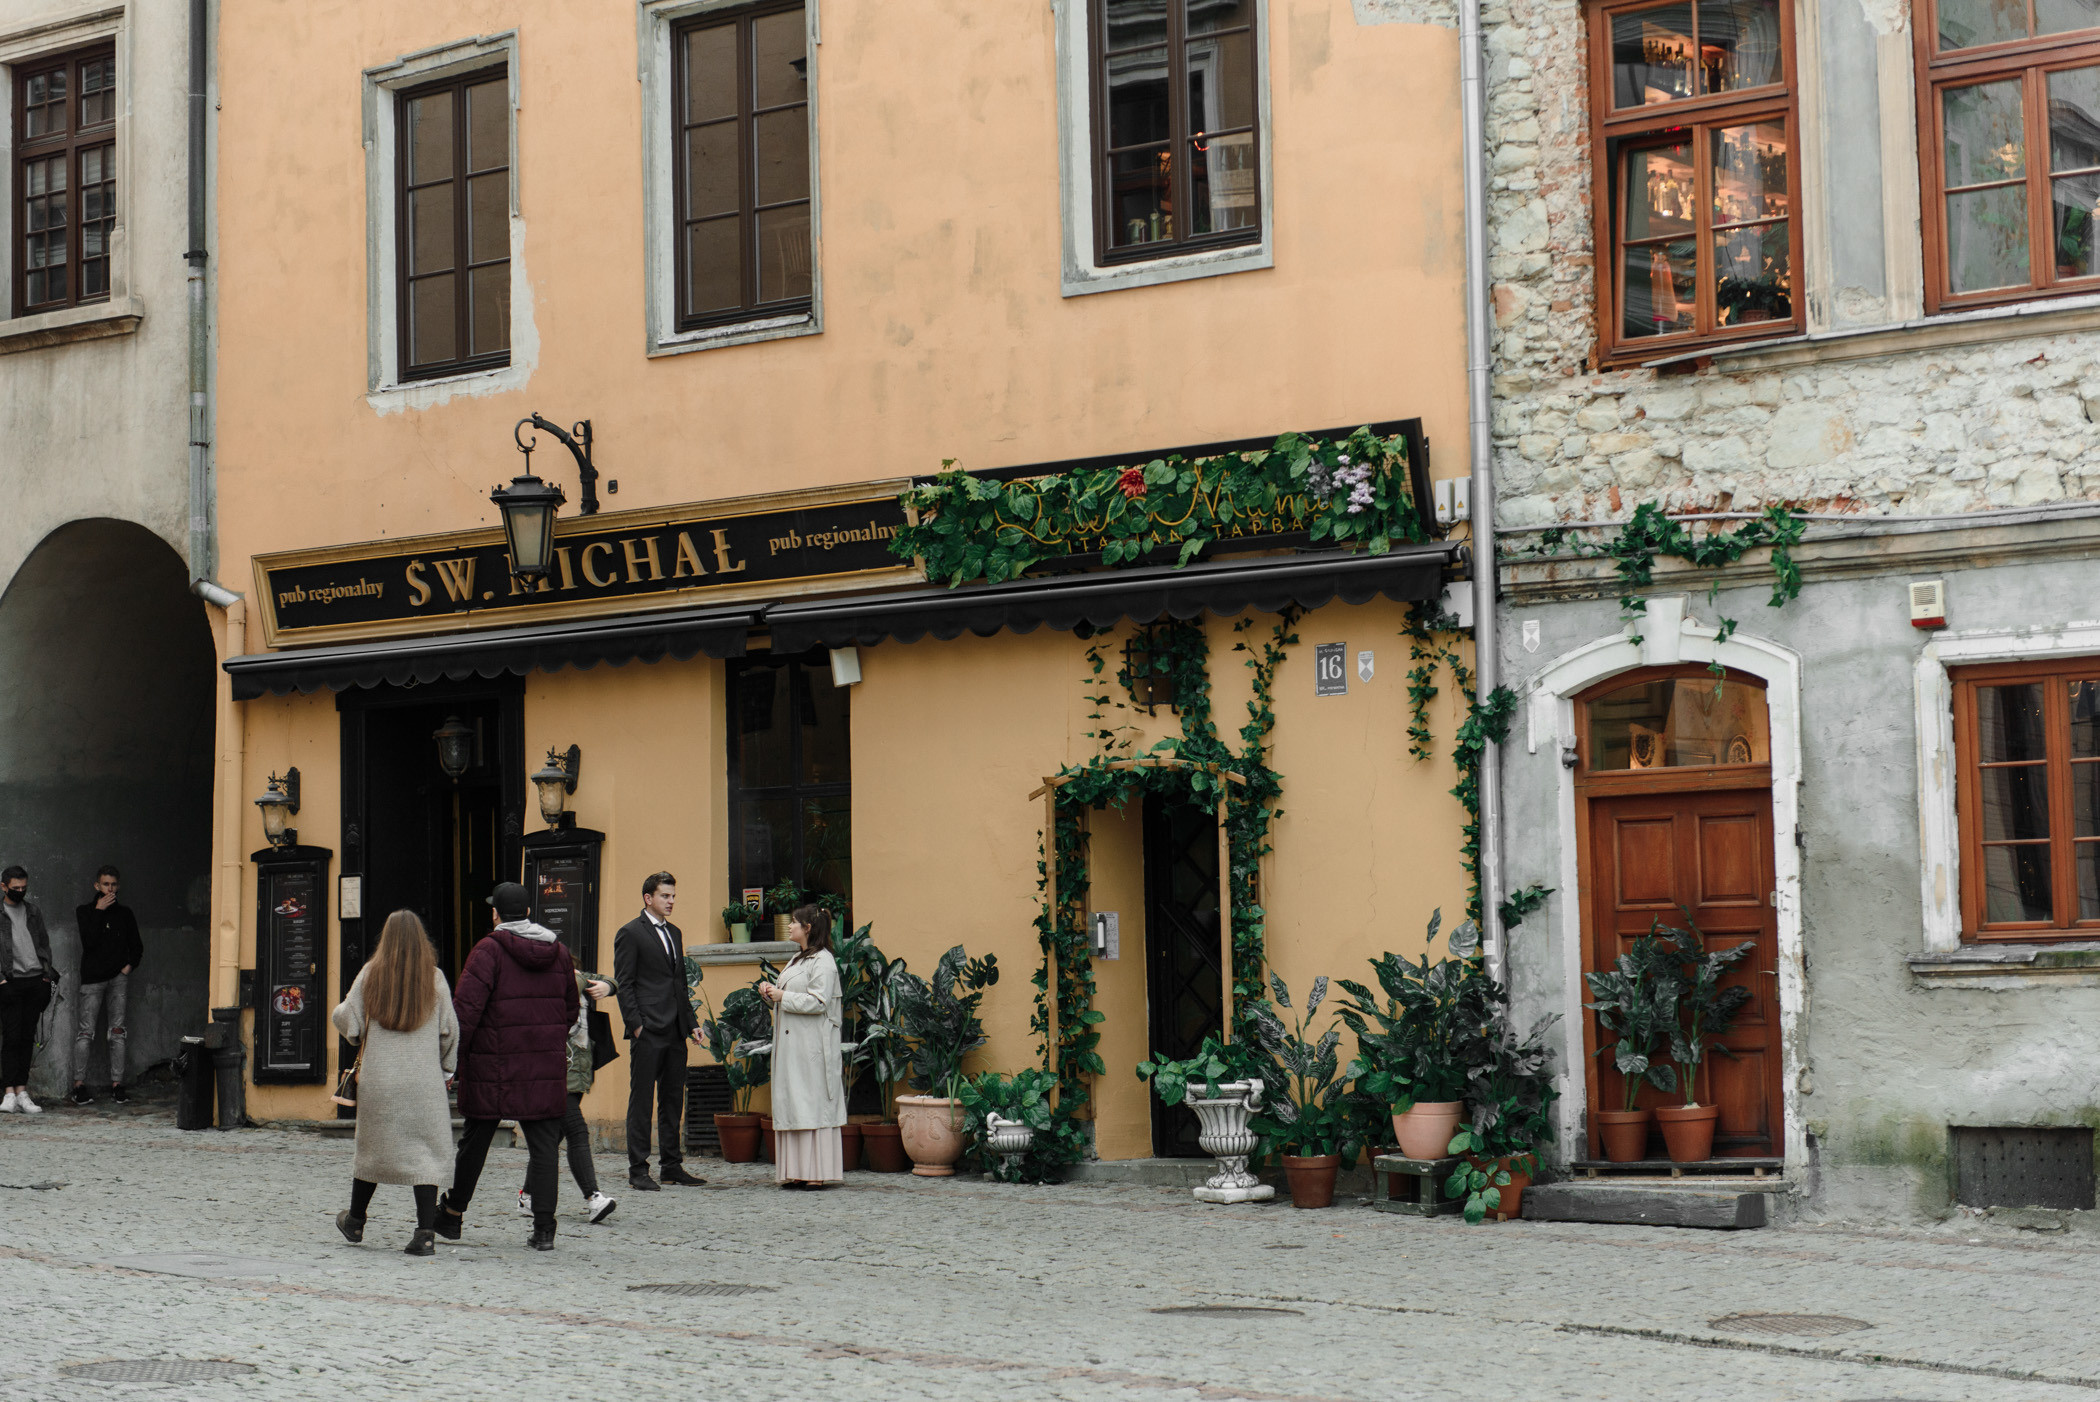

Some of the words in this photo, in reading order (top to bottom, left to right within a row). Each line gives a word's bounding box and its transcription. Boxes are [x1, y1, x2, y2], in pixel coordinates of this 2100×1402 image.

[769, 529, 802, 555] pub
[806, 520, 899, 550] regionalny
[1067, 529, 1183, 554] ITAIAN
[278, 585, 306, 608] pub
[309, 578, 384, 604] regionalny
[405, 556, 494, 607] ŚW.
[1319, 655, 1343, 680] 16
